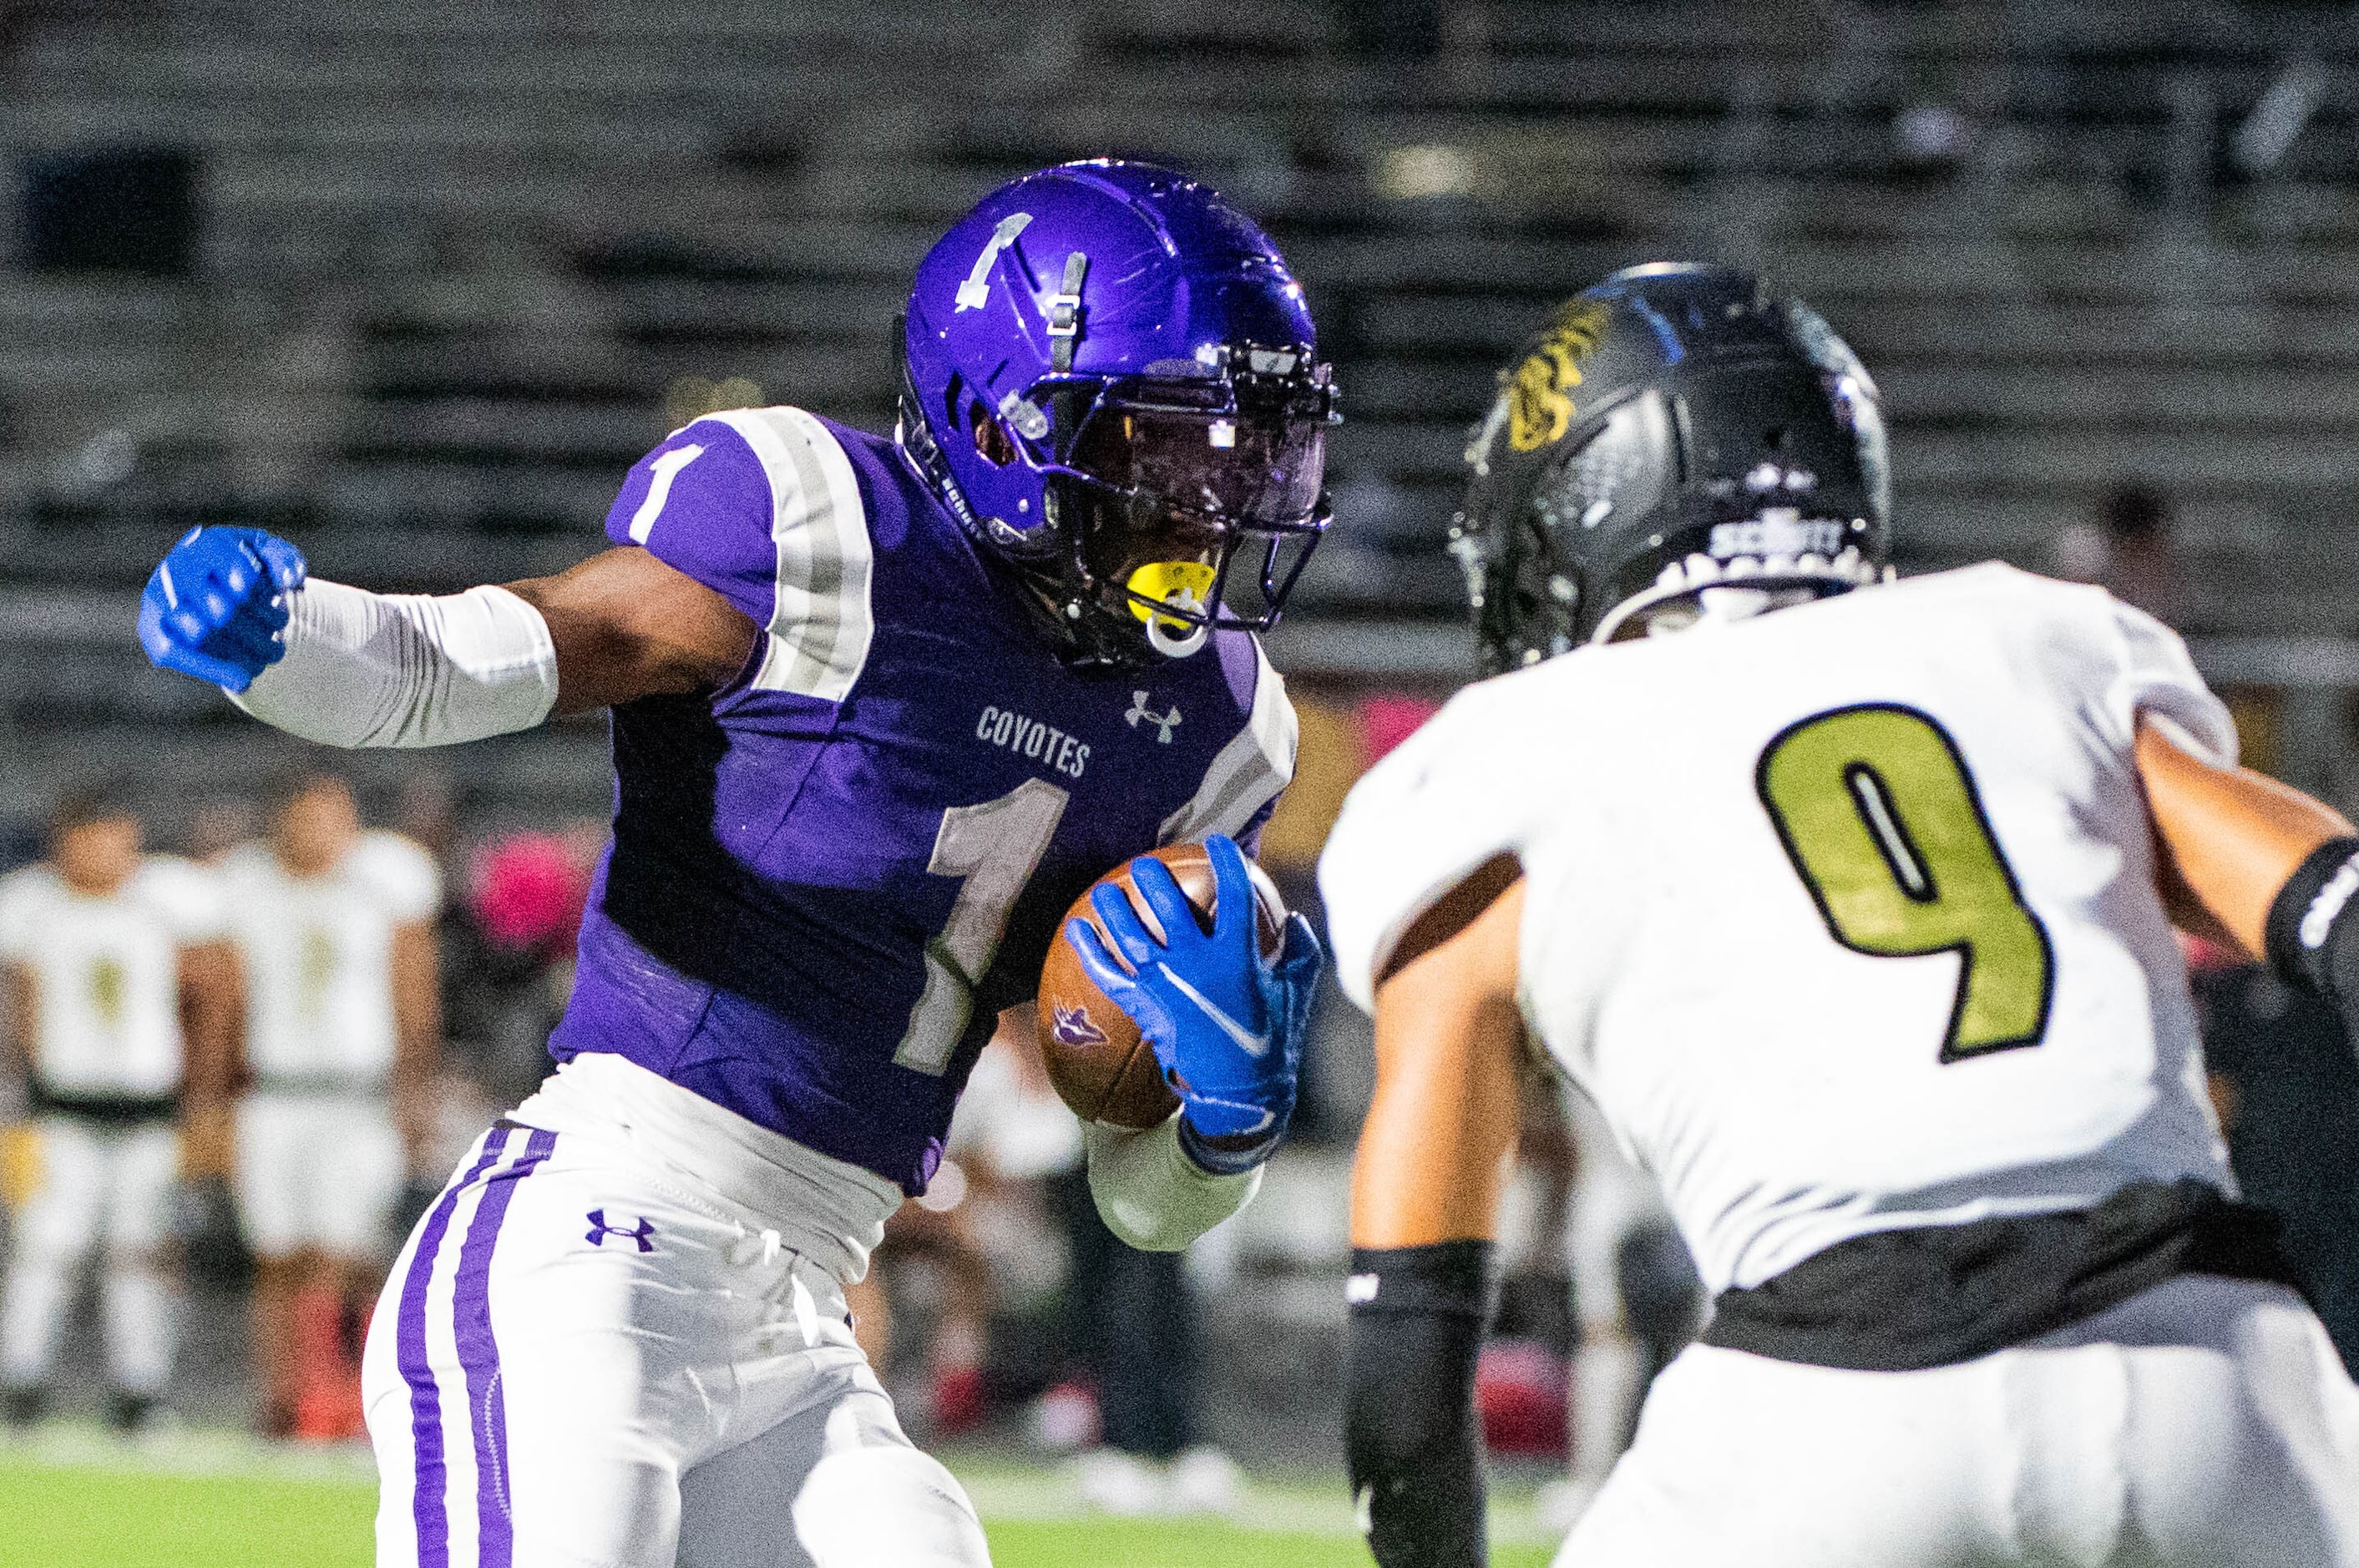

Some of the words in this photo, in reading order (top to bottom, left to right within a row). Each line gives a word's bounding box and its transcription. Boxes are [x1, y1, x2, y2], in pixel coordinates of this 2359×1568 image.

[954, 211, 1033, 314] 1
[629, 443, 705, 544] 1
[975, 705, 1091, 778] COYOTES
[892, 776, 1070, 1077] 1
[1754, 701, 2056, 1065] 9
